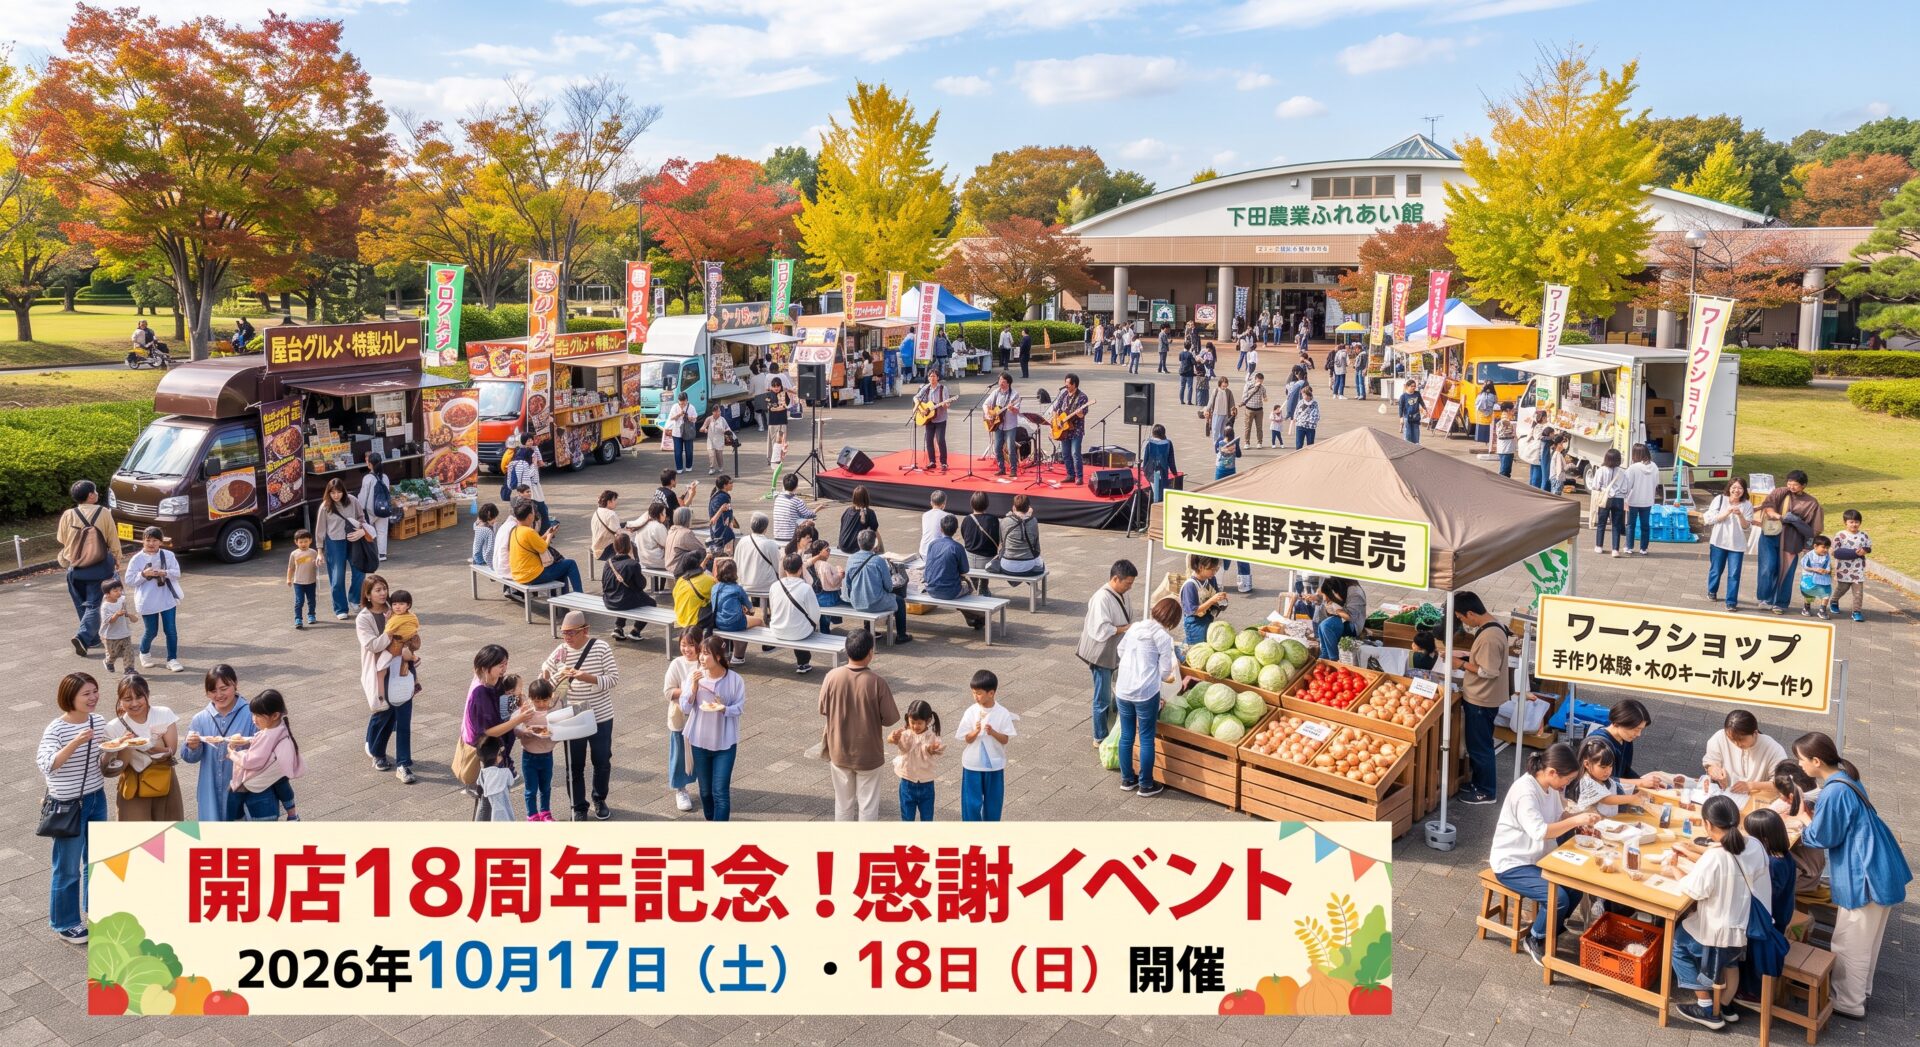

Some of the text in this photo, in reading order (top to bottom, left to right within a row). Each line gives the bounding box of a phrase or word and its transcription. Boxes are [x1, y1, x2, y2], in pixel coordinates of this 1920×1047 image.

[1226, 202, 1425, 227] 下田農業ふれあい館
[271, 330, 419, 364] 屋台グルメ・特製カレー
[1181, 505, 1406, 573] 新鮮野菜直売
[1567, 613, 1801, 663] ワークショップ
[1552, 649, 1813, 698] 手作り体験・木のキーホルダー作り
